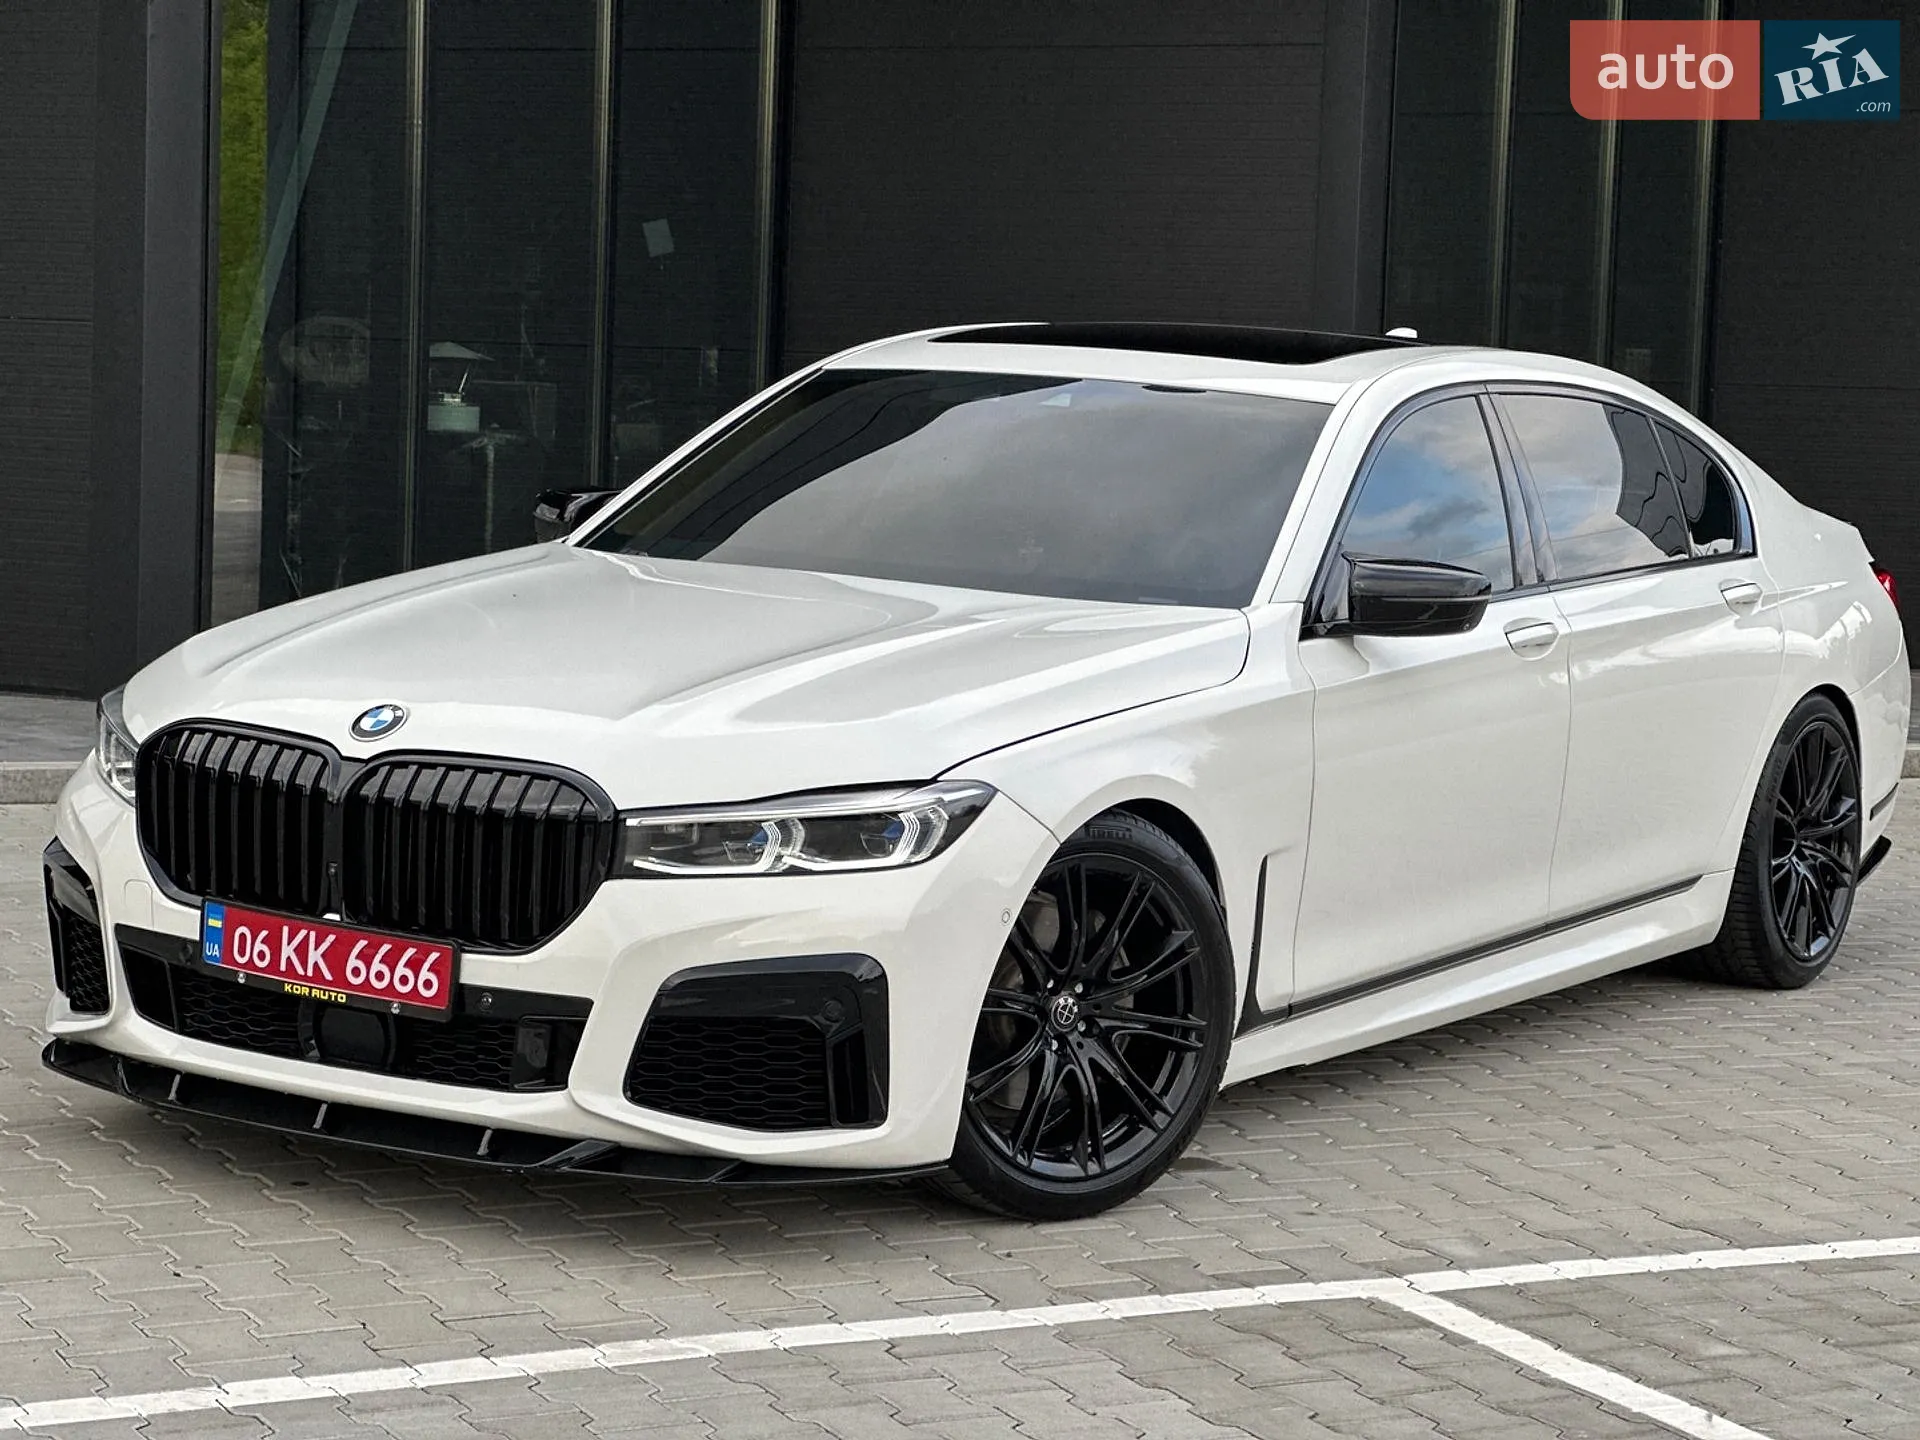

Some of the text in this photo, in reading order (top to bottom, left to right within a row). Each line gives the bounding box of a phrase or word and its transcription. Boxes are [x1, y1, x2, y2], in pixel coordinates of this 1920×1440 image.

[205, 942, 220, 958] UA
[233, 925, 441, 998] 06 KK 6666
[284, 983, 346, 1003] KOR AUTO
